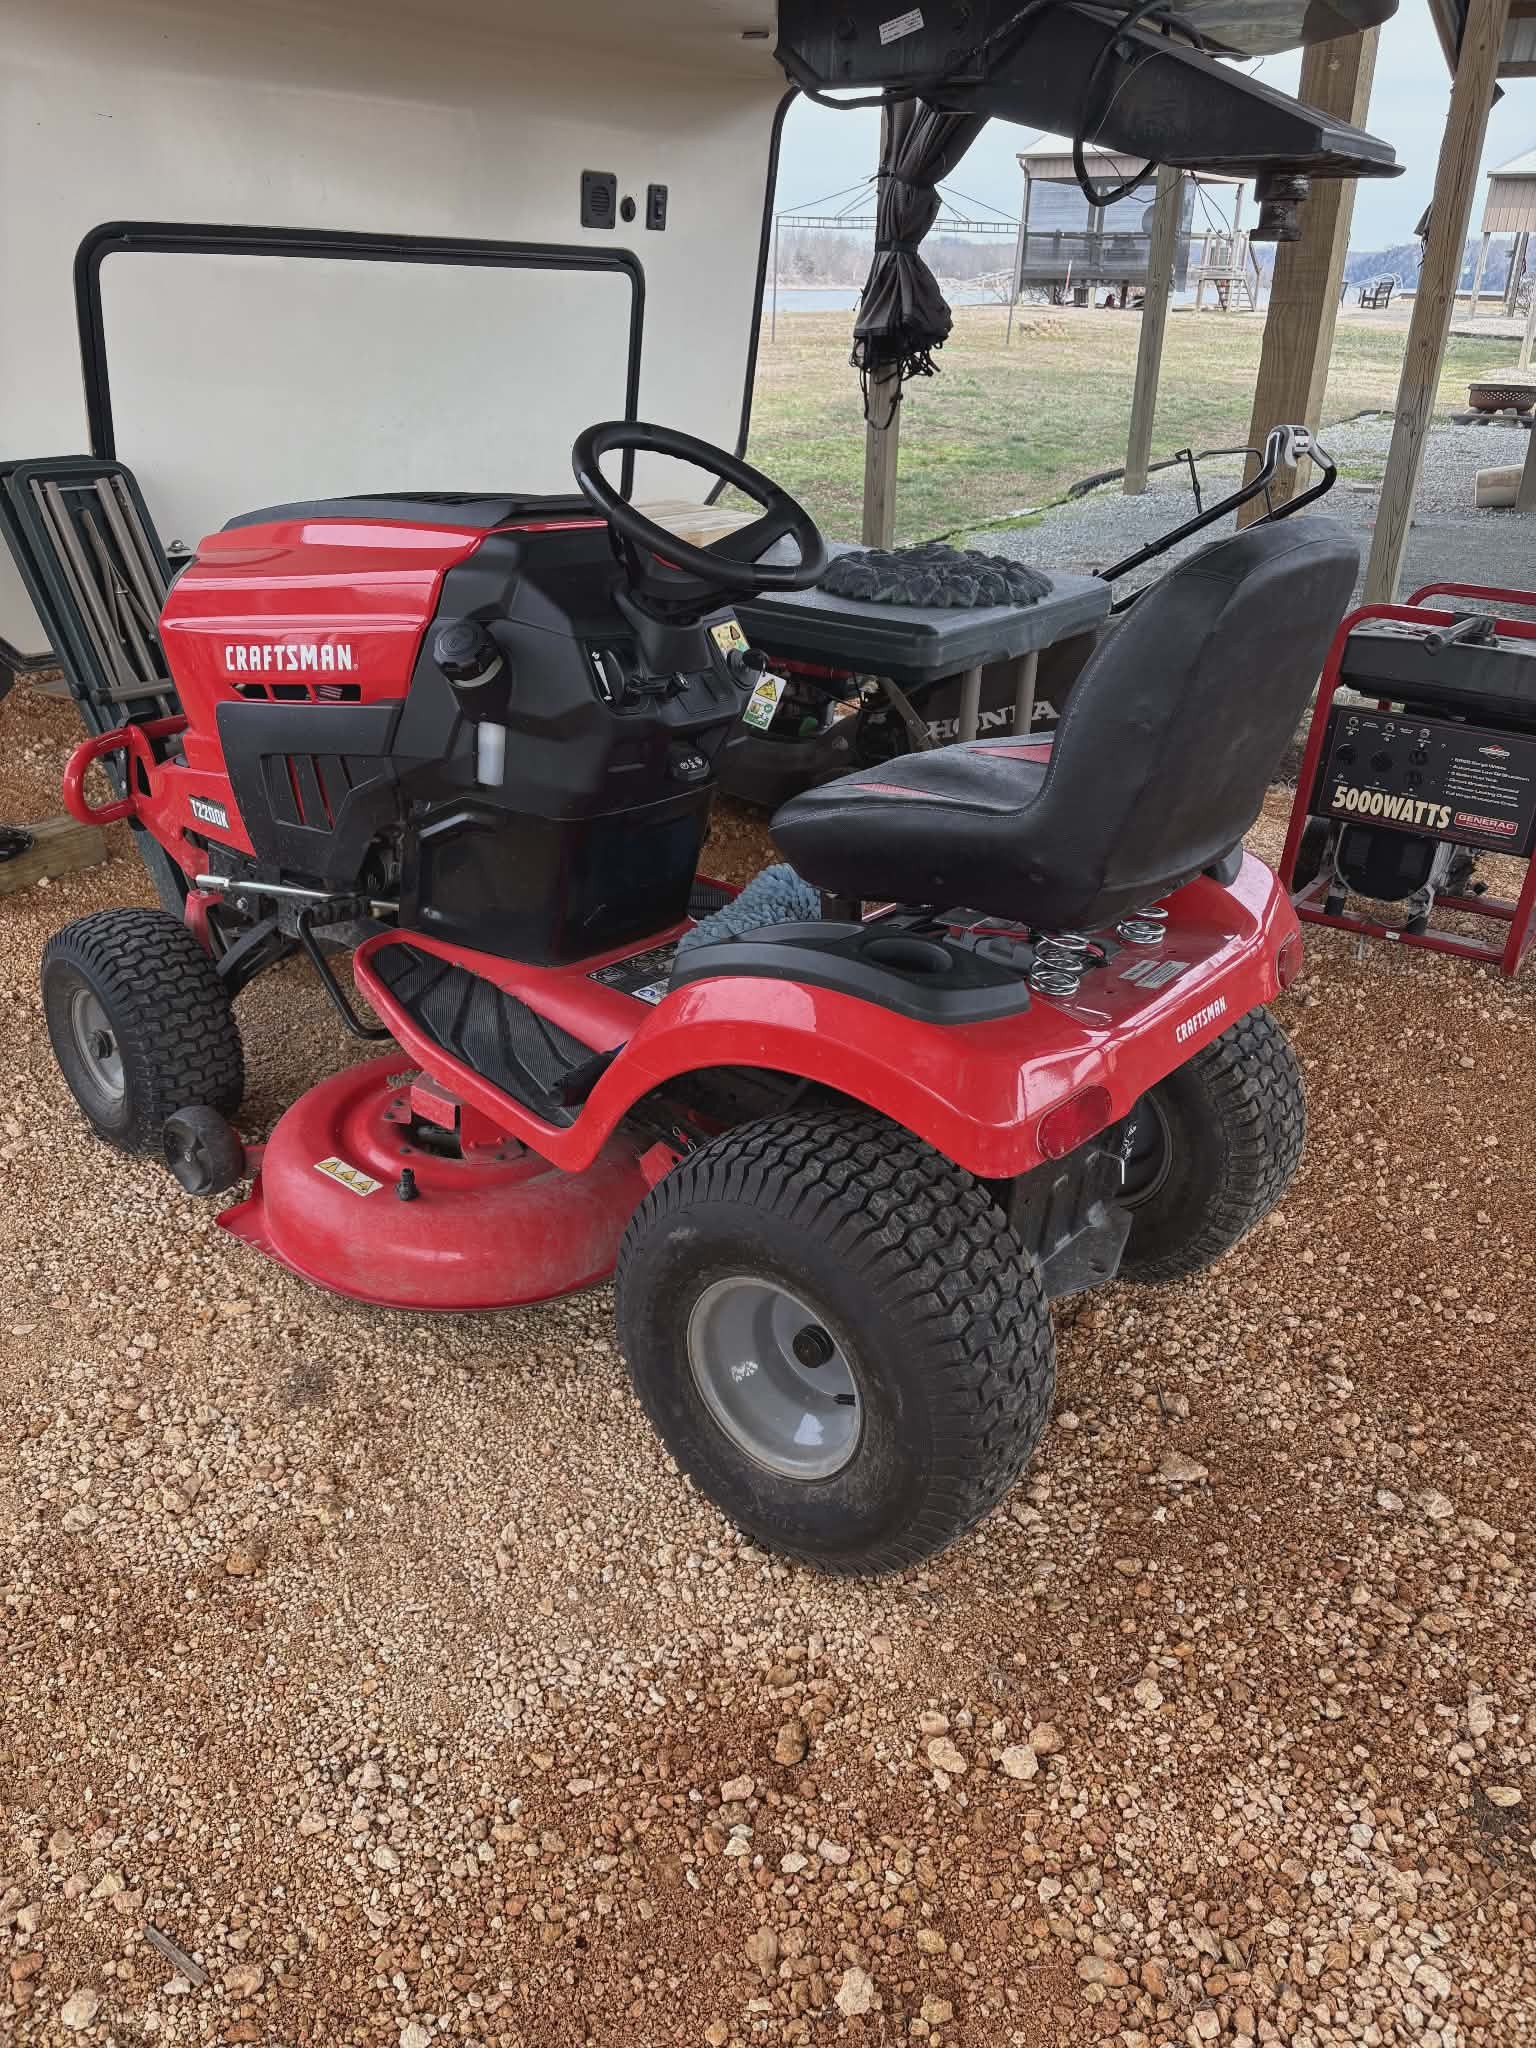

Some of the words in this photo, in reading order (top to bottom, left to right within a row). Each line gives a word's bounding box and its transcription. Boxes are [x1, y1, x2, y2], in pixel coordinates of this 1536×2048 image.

[225, 644, 352, 671] CRAFTSMAN
[925, 700, 1060, 739] HNA
[1331, 785, 1453, 829] 5000WATTS
[1458, 814, 1515, 831] GENERAC
[1175, 995, 1226, 1043] CRAFTSMAN
